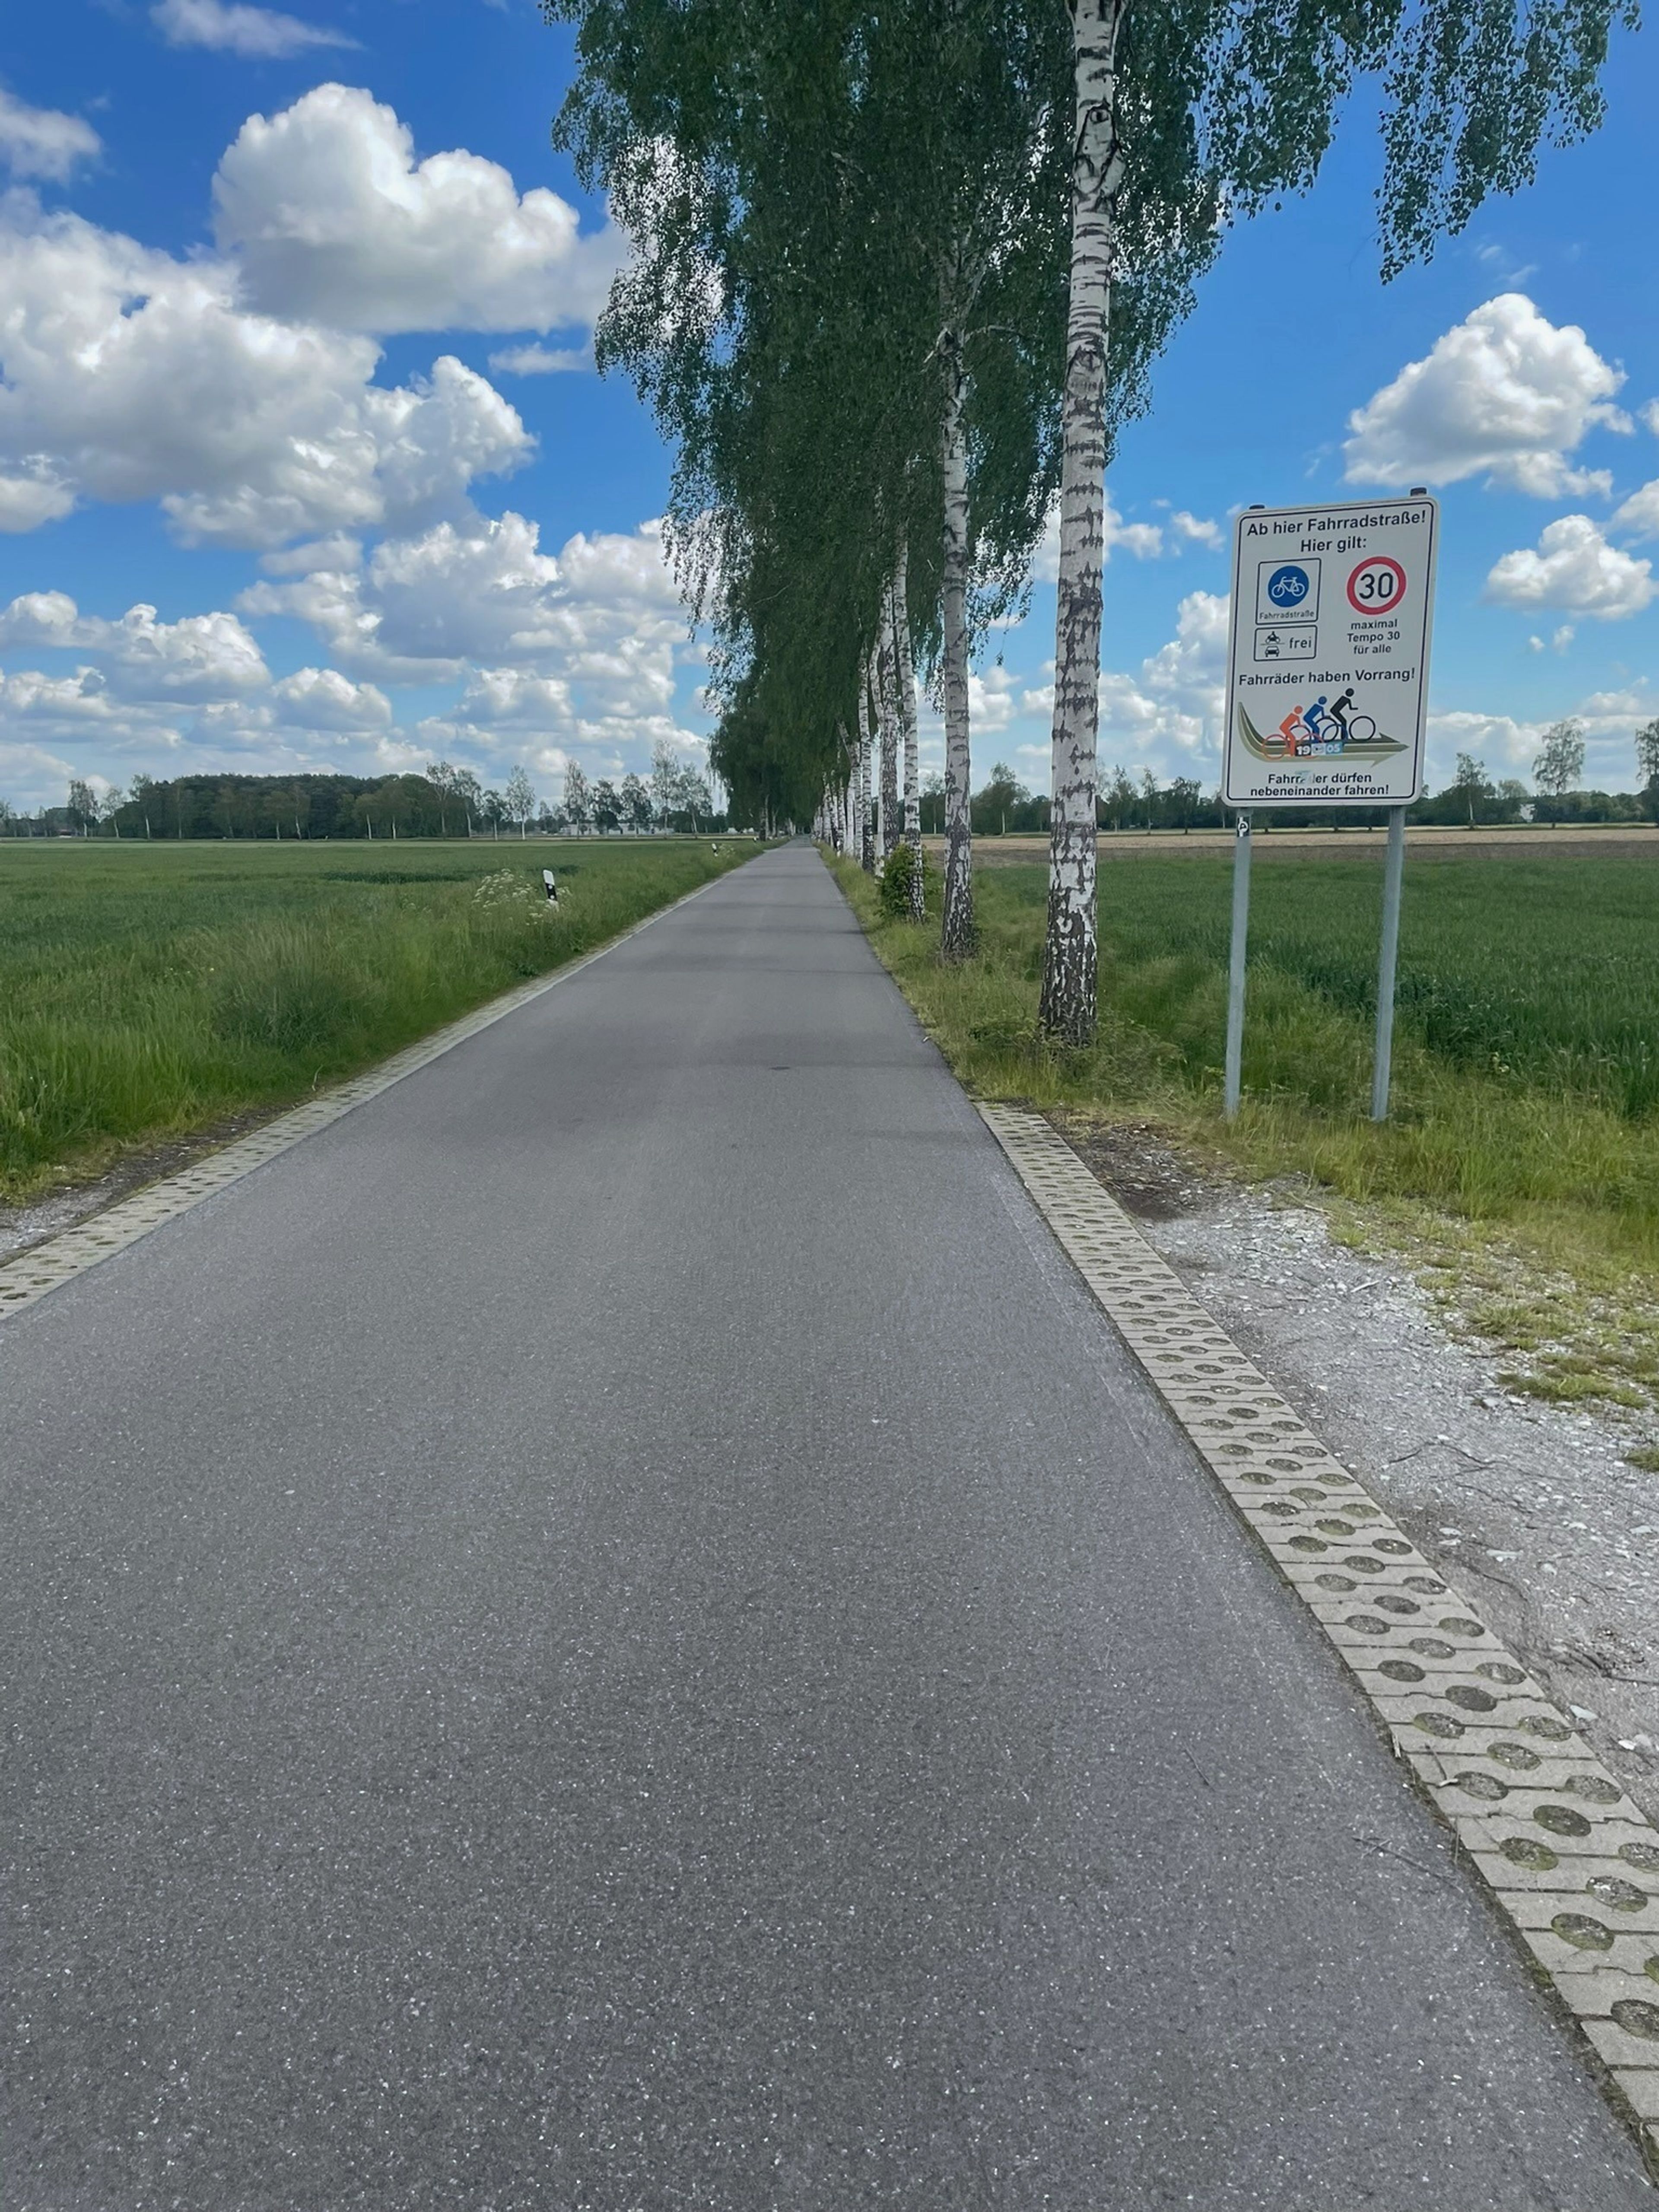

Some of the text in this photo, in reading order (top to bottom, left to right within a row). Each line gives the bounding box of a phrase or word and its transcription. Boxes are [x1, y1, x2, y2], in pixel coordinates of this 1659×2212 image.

[1247, 510, 1426, 536] Ab hier Fahrradstraße!
[1300, 536, 1367, 553] Hier gilt:
[1359, 572, 1393, 600] 30
[1259, 610, 1315, 620] Fahrradstraße
[1351, 619, 1398, 630] maximal
[1289, 636, 1312, 649] frei
[1347, 631, 1400, 643] Tempo 30
[1354, 644, 1392, 655] für alle
[1239, 668, 1415, 686] Fahrräder haben Vorrang!
[1297, 745, 1310, 755] 19
[1268, 772, 1372, 785] Fahrrer dürfen
[1251, 784, 1389, 796] nebeneinander fahren!
